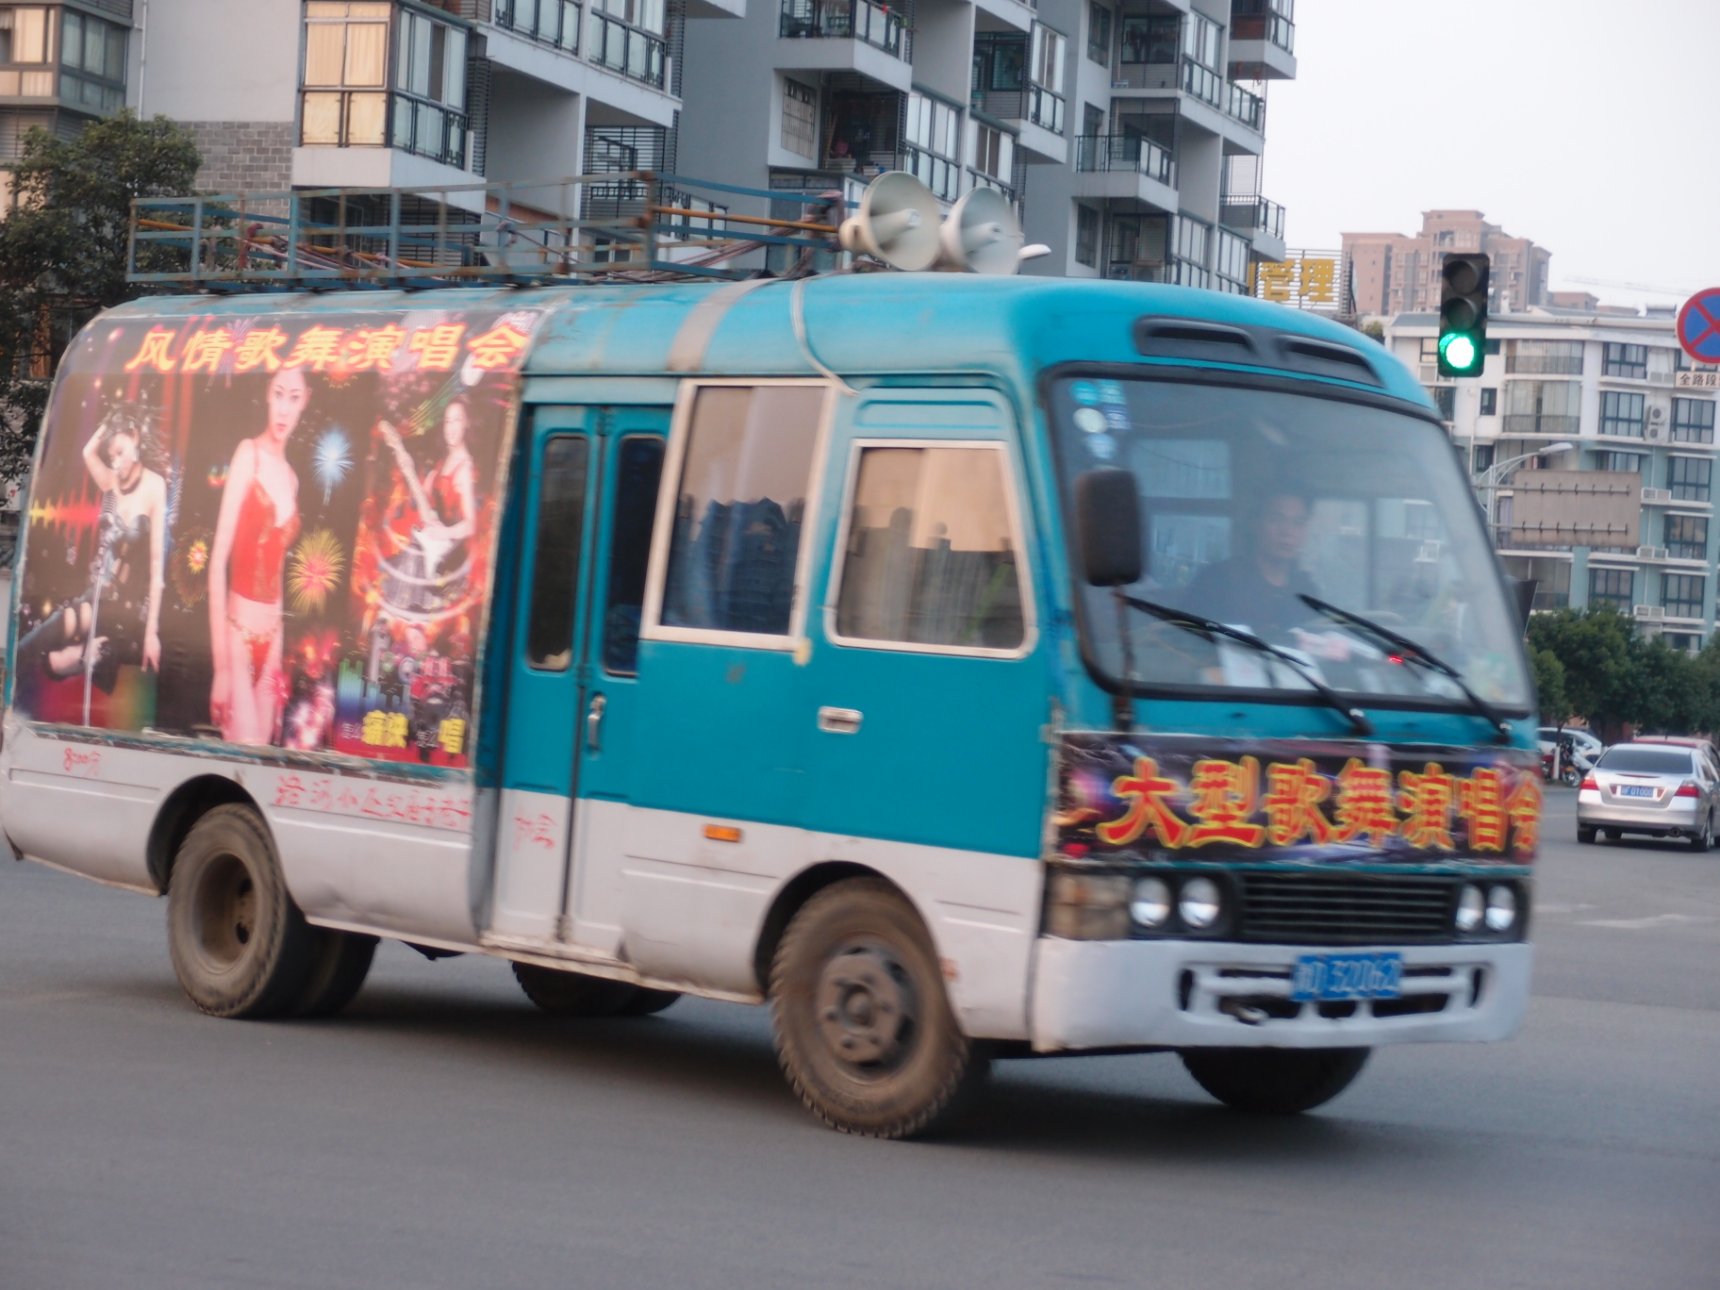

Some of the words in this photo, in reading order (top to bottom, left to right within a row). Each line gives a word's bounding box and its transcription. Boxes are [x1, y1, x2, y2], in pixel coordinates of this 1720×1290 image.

[1248, 258, 1335, 302] 管理
[125, 322, 529, 372] 风情歌舞演唱会
[1680, 372, 1720, 386] 全路段
[1096, 755, 1543, 852] 大型歌舞演唱会
